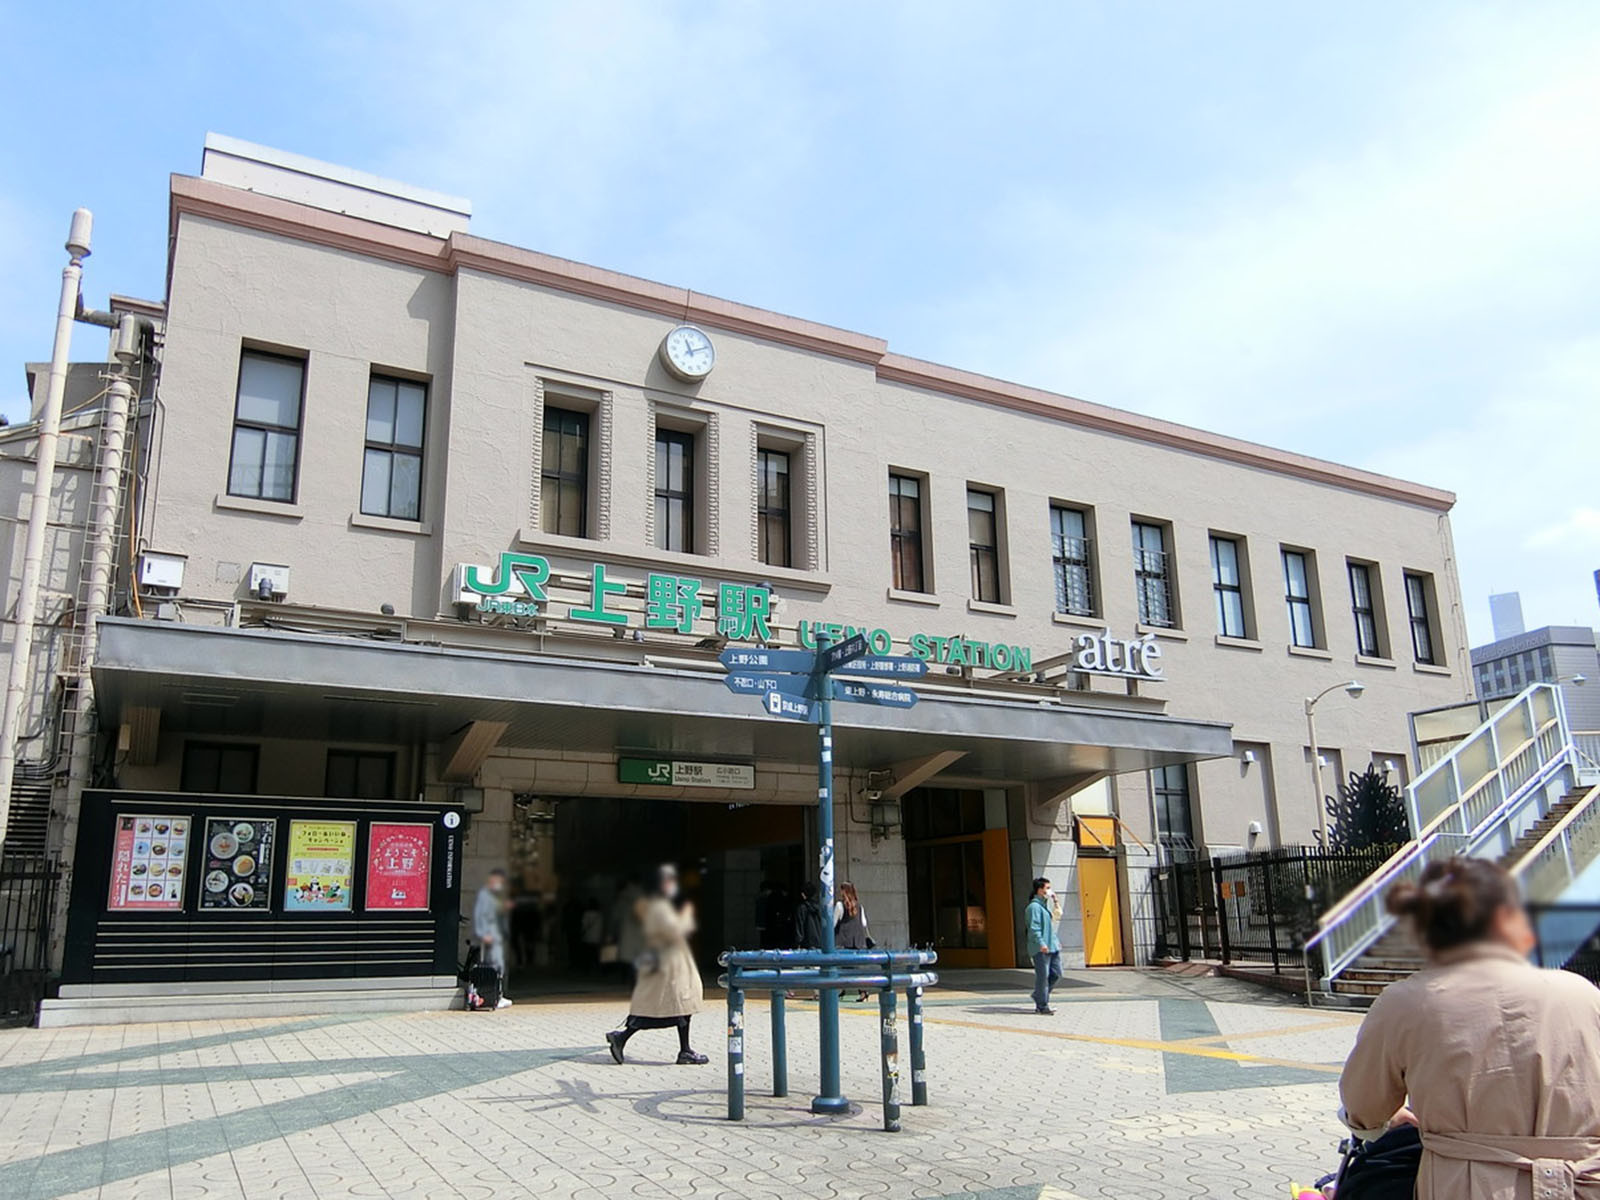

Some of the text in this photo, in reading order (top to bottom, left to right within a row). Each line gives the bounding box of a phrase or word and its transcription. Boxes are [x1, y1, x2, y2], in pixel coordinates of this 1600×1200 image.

[465, 551, 551, 602] JR
[569, 563, 772, 643] 上野駅
[910, 633, 1033, 673] STATION
[1077, 627, 1166, 676] atré
[728, 654, 769, 666] 上野公園
[647, 763, 671, 778] JR
[674, 764, 704, 776] 上野駅
[384, 847, 417, 857] ようこそ
[384, 857, 414, 870] 上野
